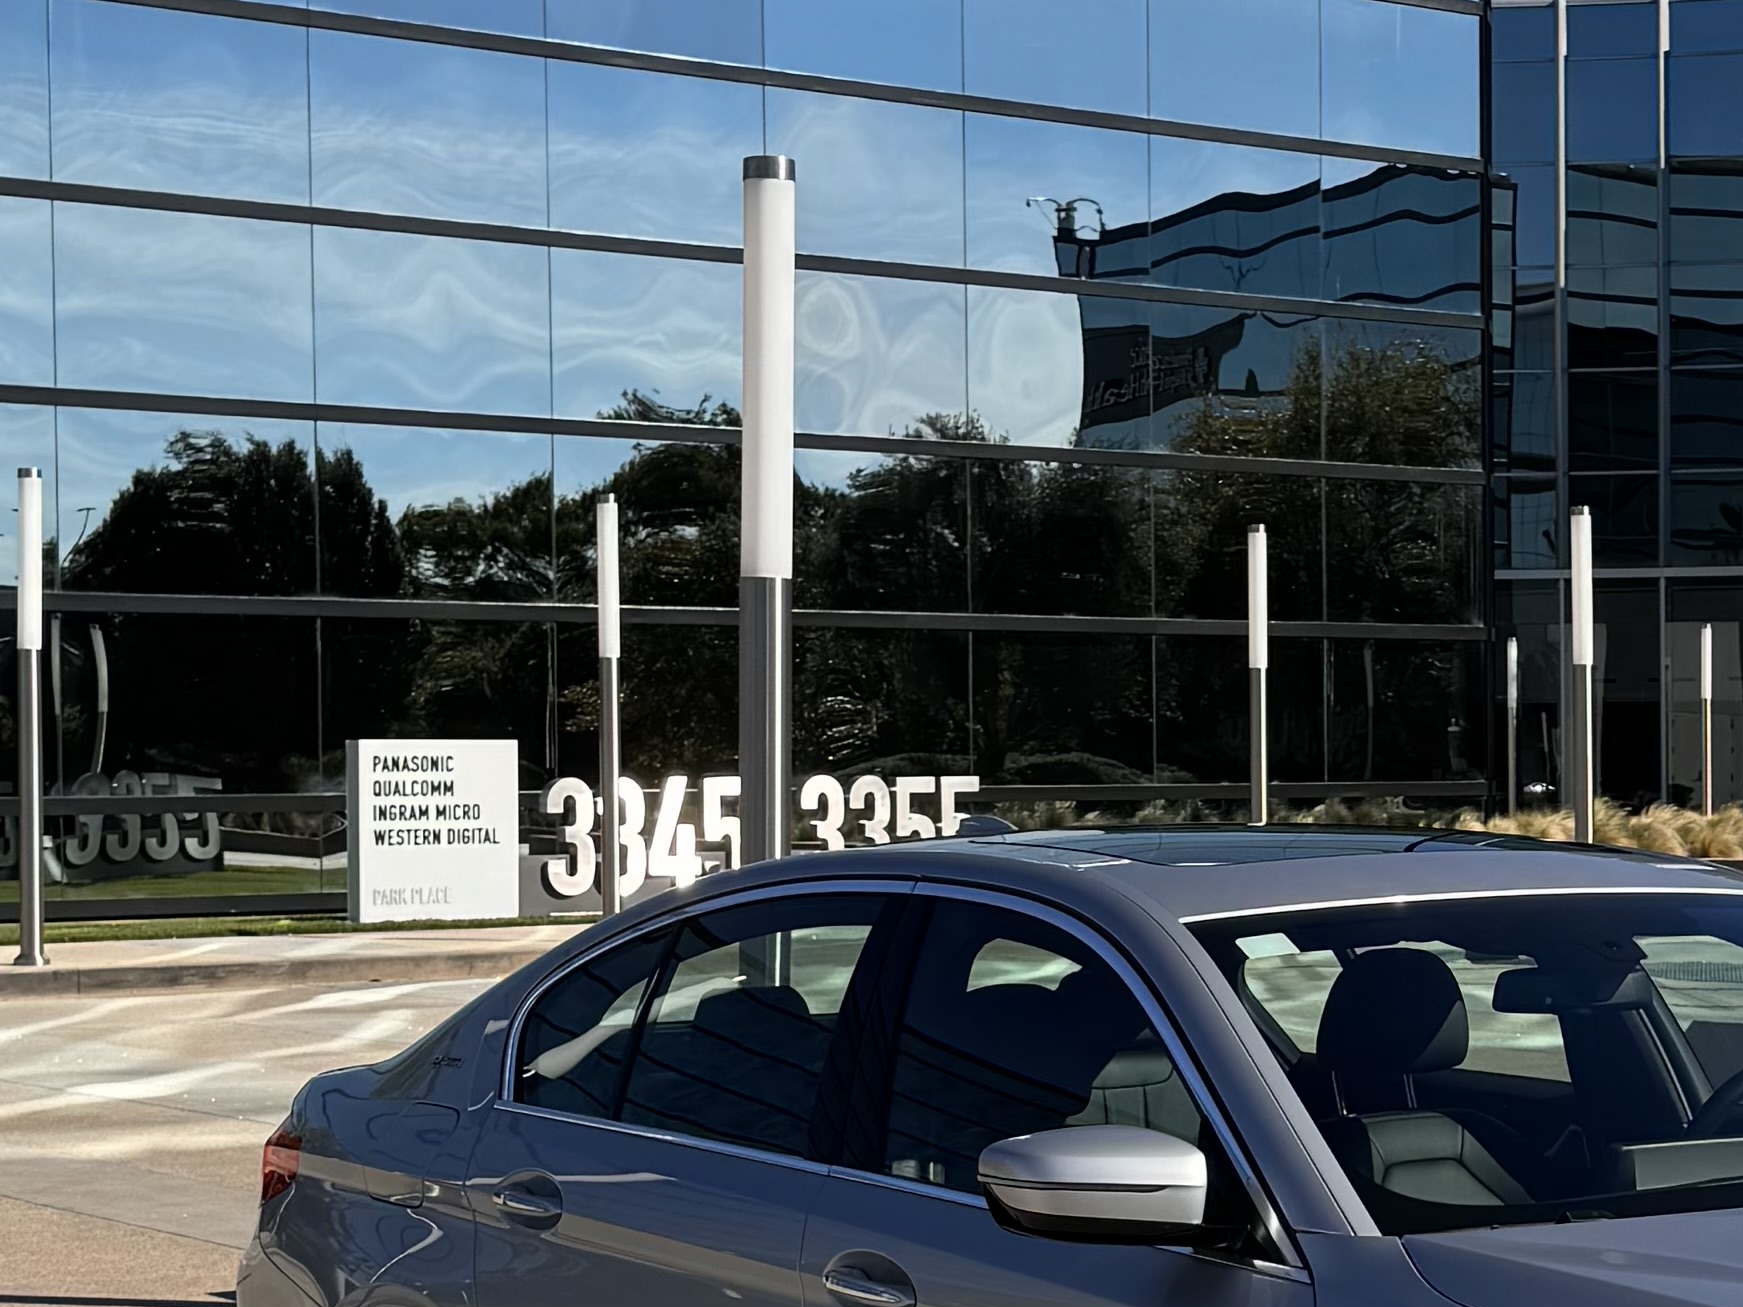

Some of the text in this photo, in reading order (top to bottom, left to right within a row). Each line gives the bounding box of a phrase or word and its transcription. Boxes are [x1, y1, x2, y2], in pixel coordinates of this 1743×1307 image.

[372, 755, 454, 773] PANASONIC
[372, 780, 454, 797] QUALCOMM
[372, 803, 481, 821] INGRAM MICRO
[373, 827, 500, 846] WESTERN DIGITAL
[372, 886, 453, 906] PARK PLACE
